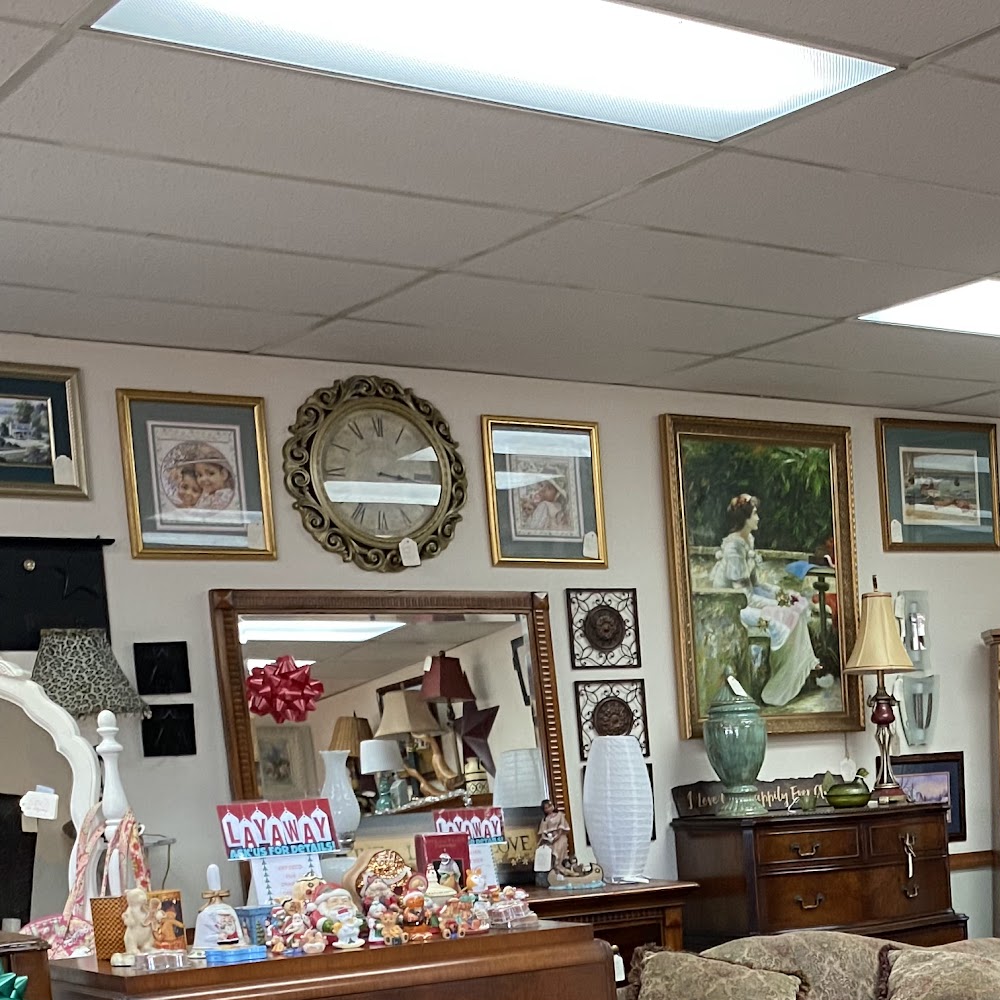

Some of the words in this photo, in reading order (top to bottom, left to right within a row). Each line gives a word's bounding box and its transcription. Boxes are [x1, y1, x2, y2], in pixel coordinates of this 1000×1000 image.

[755, 785, 789, 808] appily
[226, 817, 325, 849] LAYAWAY
[230, 848, 251, 860] ASK
[252, 846, 267, 856] US
[269, 844, 290, 856] FOR
[496, 836, 532, 853] OVE
